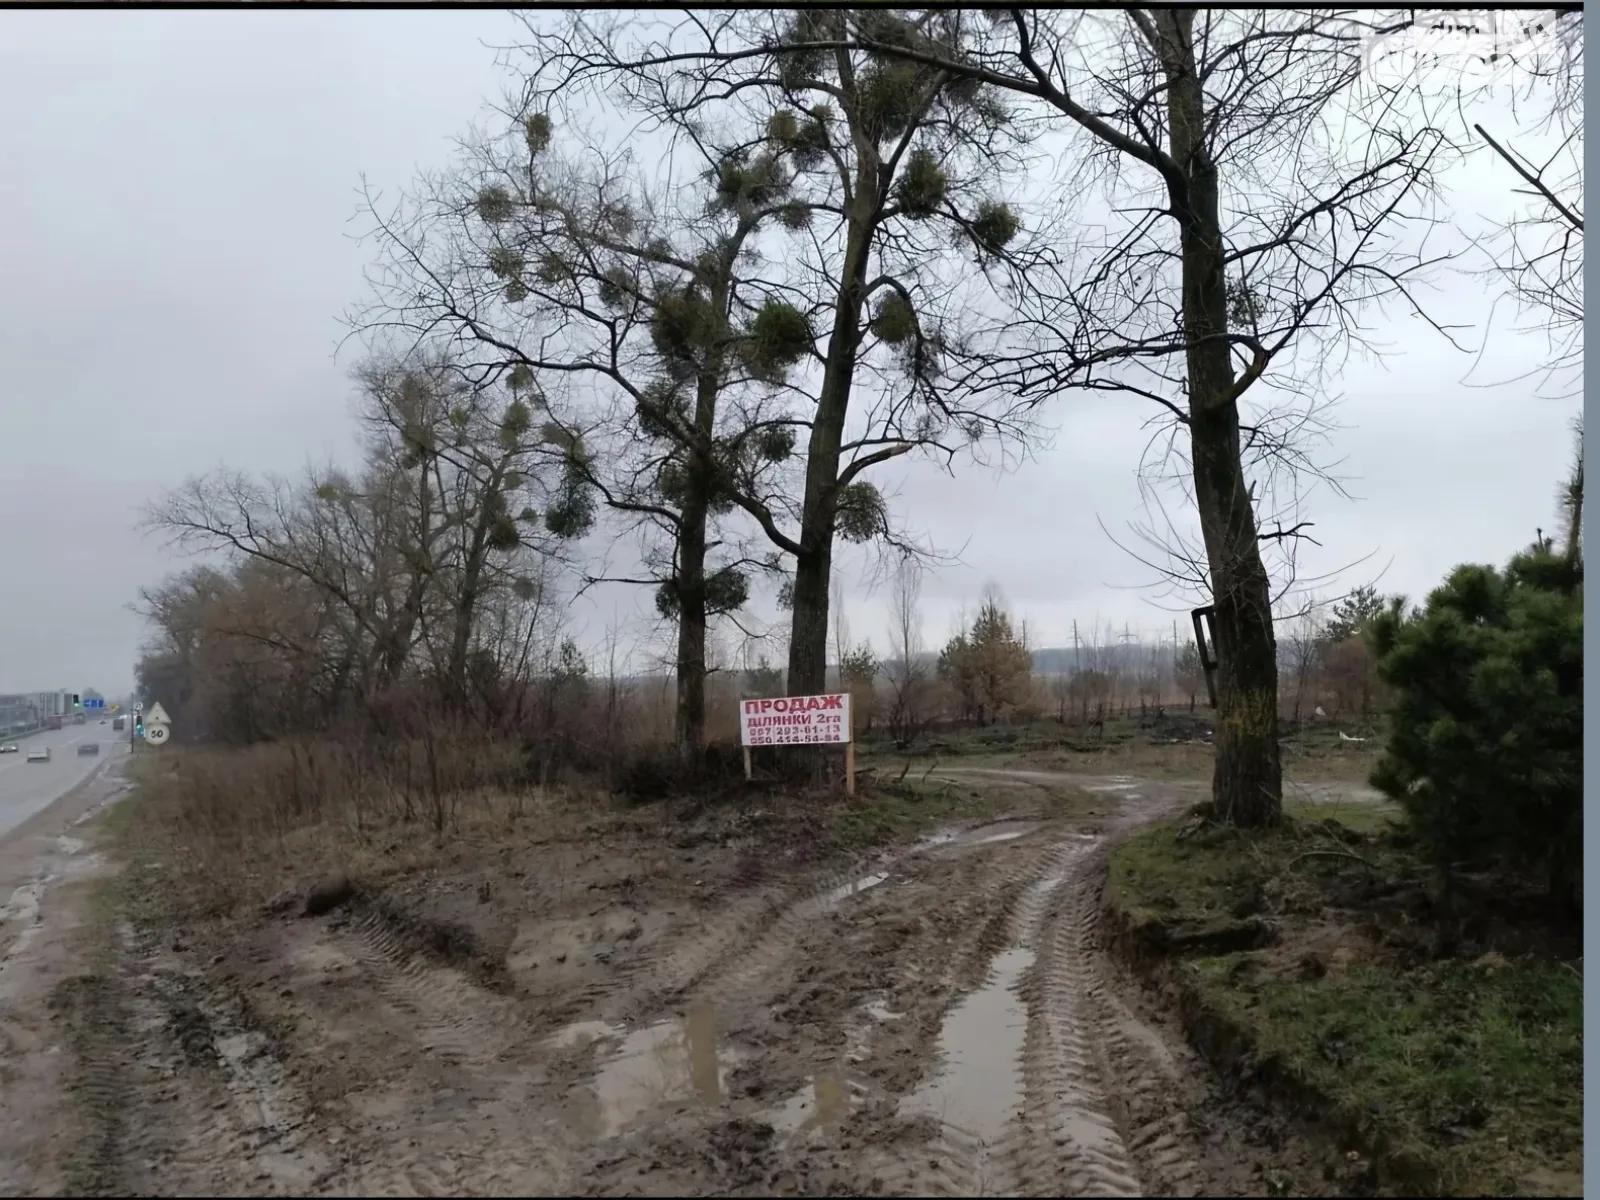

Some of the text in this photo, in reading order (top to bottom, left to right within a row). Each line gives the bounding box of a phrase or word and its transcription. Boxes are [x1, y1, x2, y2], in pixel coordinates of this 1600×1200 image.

[745, 695, 843, 715] ПРОДАЖ
[747, 714, 811, 728] ДІЛЯНКИ
[150, 729, 164, 739] 50
[750, 736, 772, 745] 050
